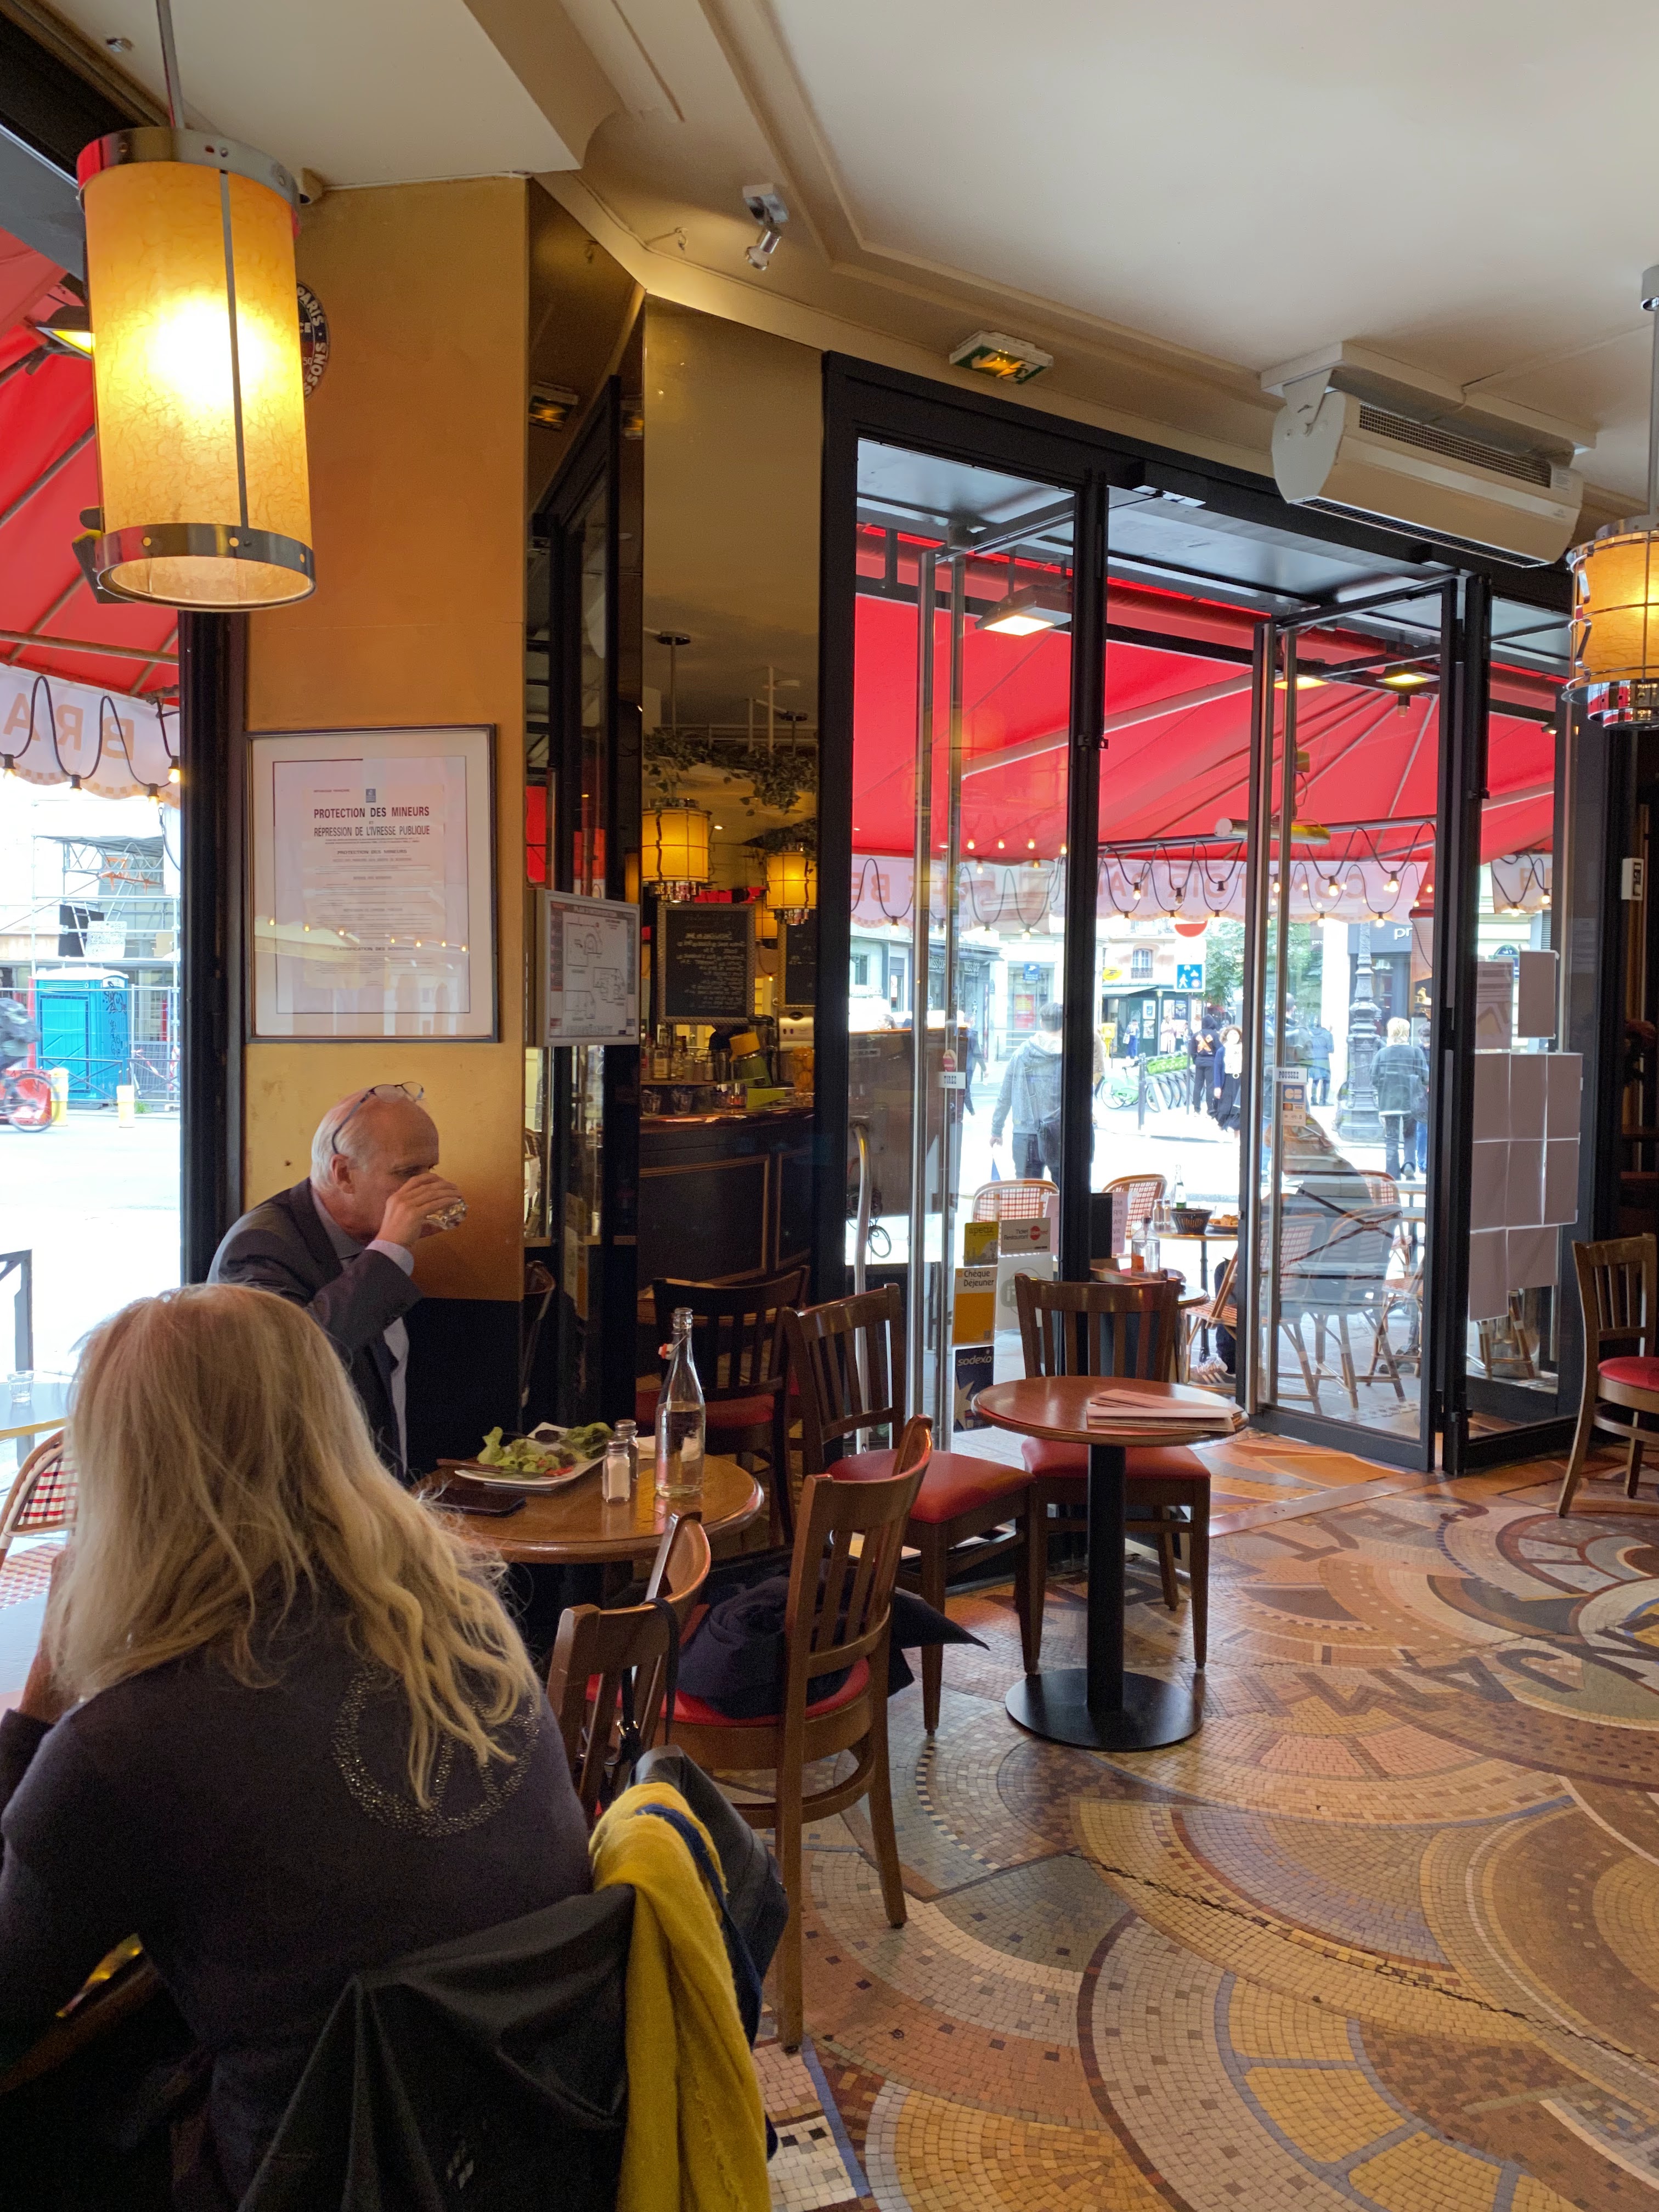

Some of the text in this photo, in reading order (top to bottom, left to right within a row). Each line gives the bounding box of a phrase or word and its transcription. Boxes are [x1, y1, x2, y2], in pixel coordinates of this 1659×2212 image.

[297, 286, 325, 328] PARIS
[314, 806, 430, 819] PROTECTION DES MINEURS
[314, 825, 430, 837] RÉPRESSION DE L'IVRESSE PUBLIQUE
[963, 1279, 994, 1288] Déjeuner
[957, 1355, 992, 1367] sodexo
